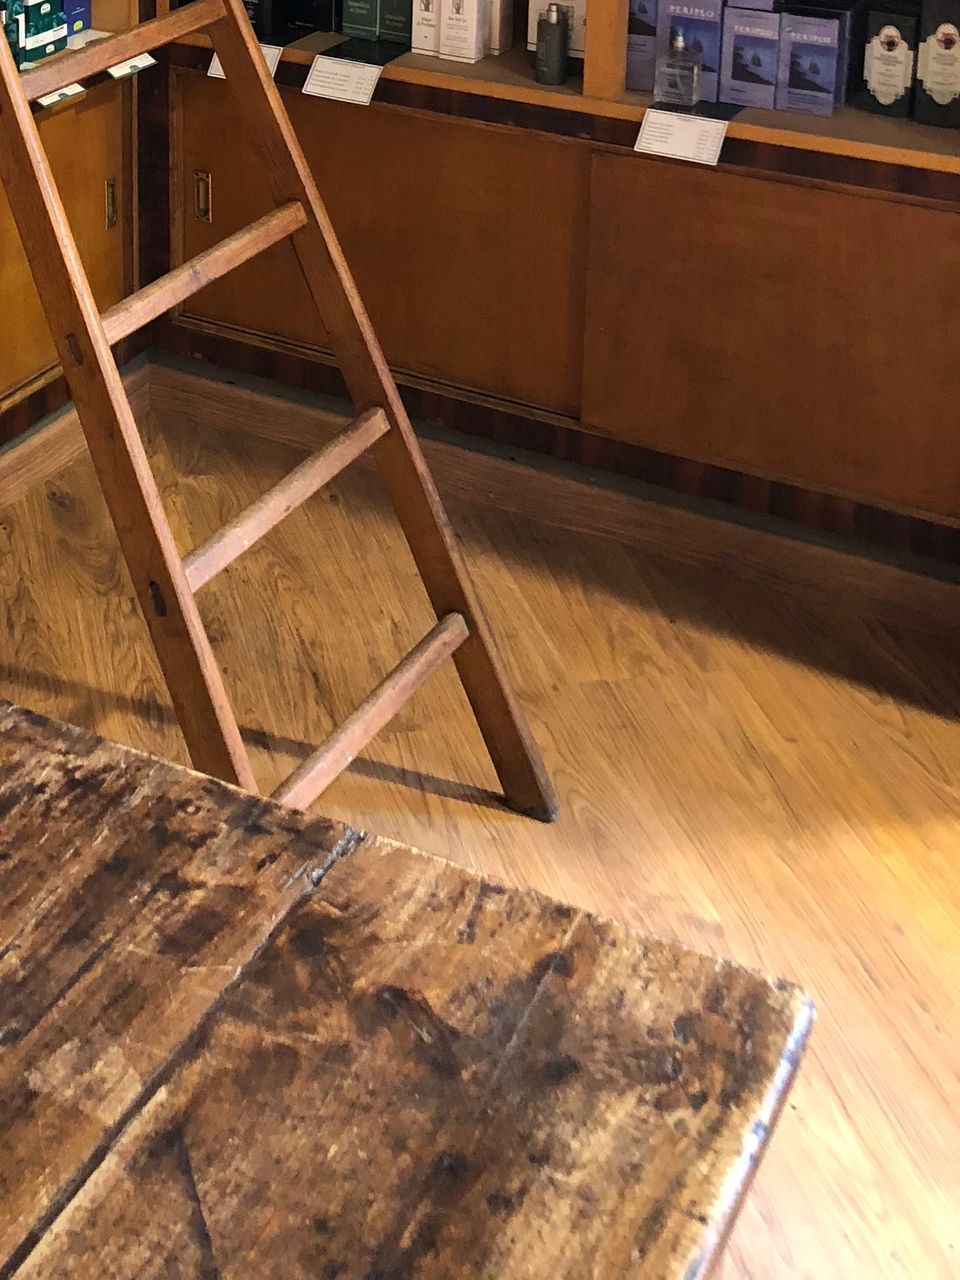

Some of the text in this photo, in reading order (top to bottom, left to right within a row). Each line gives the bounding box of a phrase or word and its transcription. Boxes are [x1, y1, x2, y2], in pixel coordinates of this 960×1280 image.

[669, 5, 715, 18] PERIPLO
[734, 24, 776, 37] PERIPLO
[790, 32, 832, 45] PERIPLO
